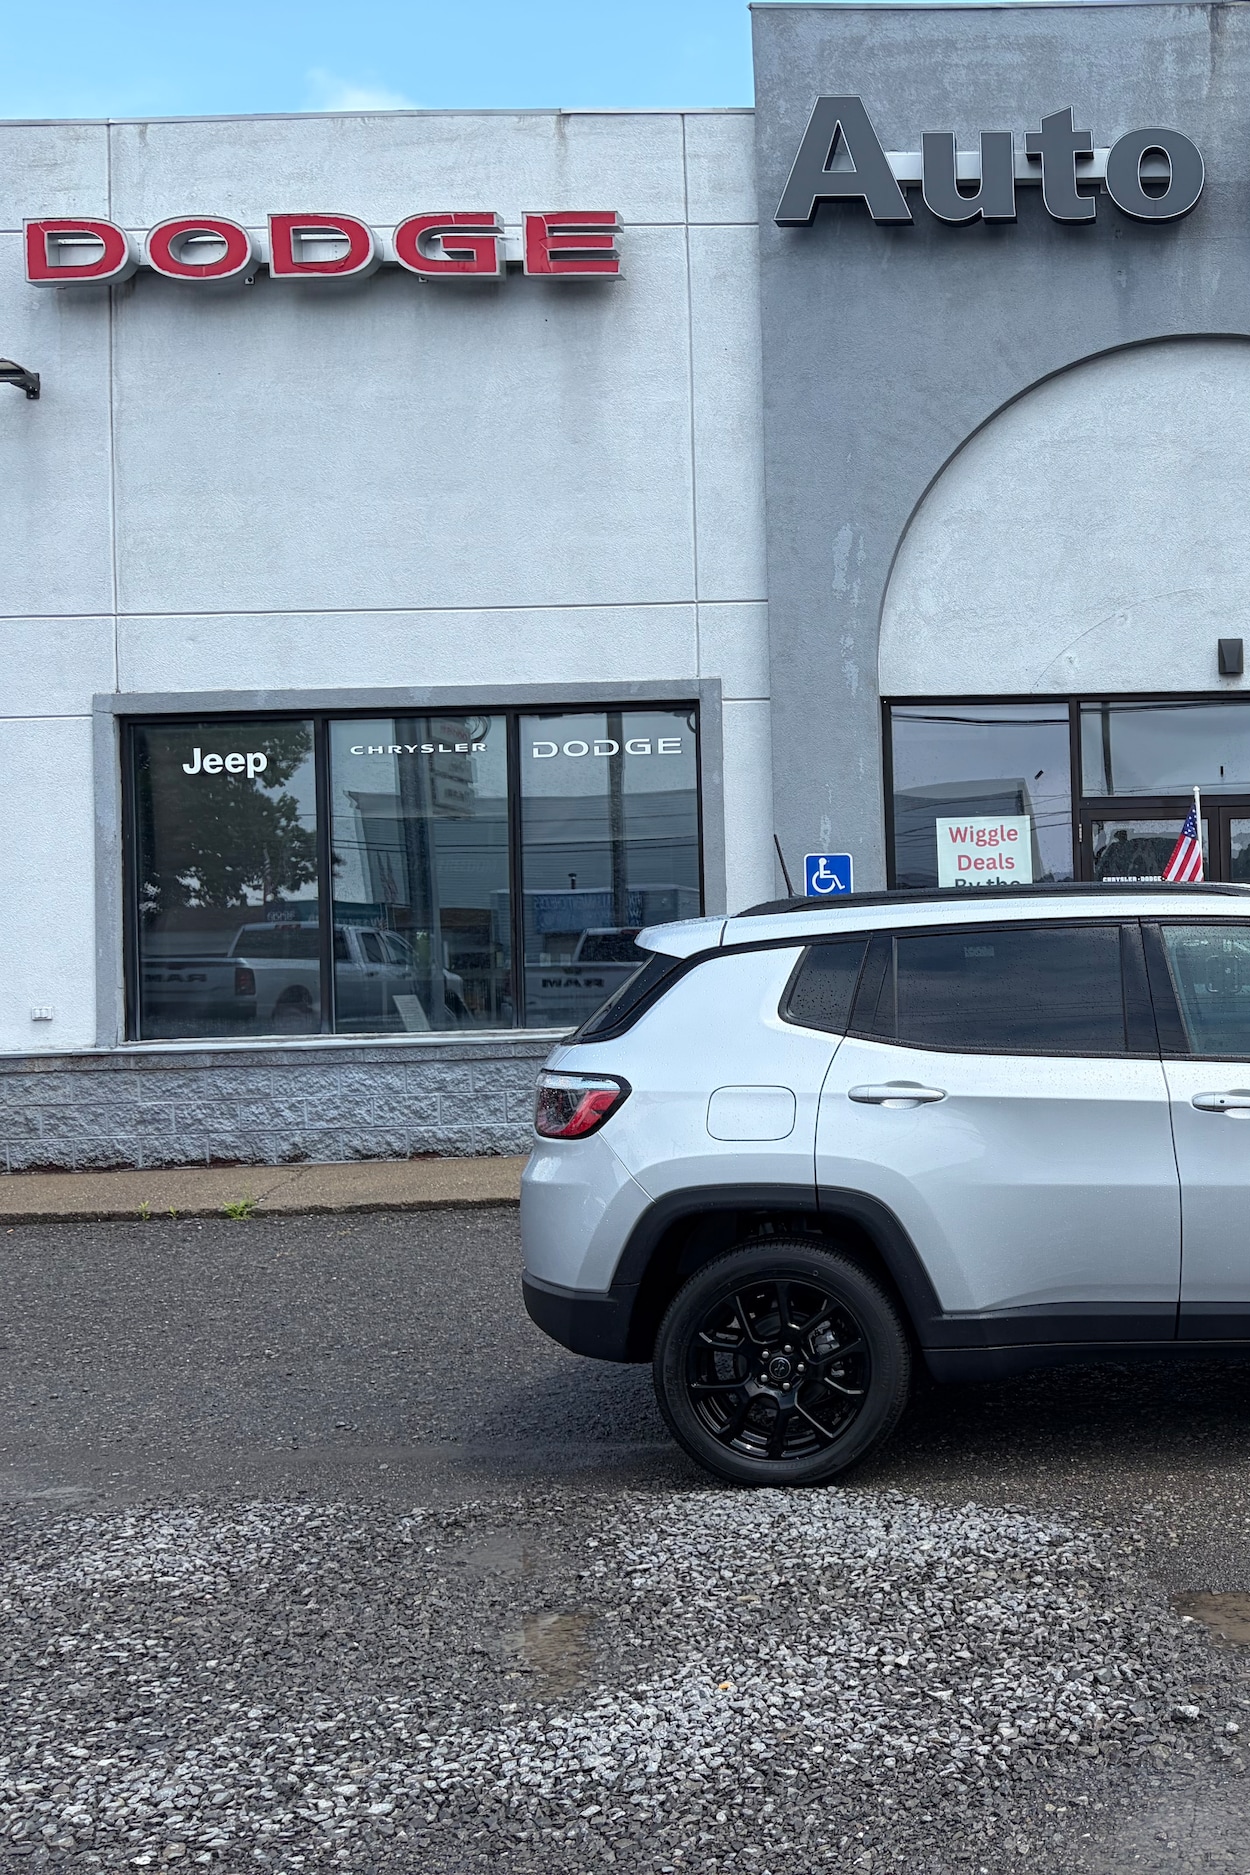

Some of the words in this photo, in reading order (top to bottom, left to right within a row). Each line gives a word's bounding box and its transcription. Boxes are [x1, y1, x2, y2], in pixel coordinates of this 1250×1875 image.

[774, 94, 1205, 226] Auto
[23, 211, 623, 287] DODGE
[350, 742, 488, 755] CHRYSLER
[532, 737, 683, 758] DODGE
[182, 747, 268, 779] Jeep
[948, 825, 1018, 847] Wiggle
[957, 852, 1015, 871] Deals
